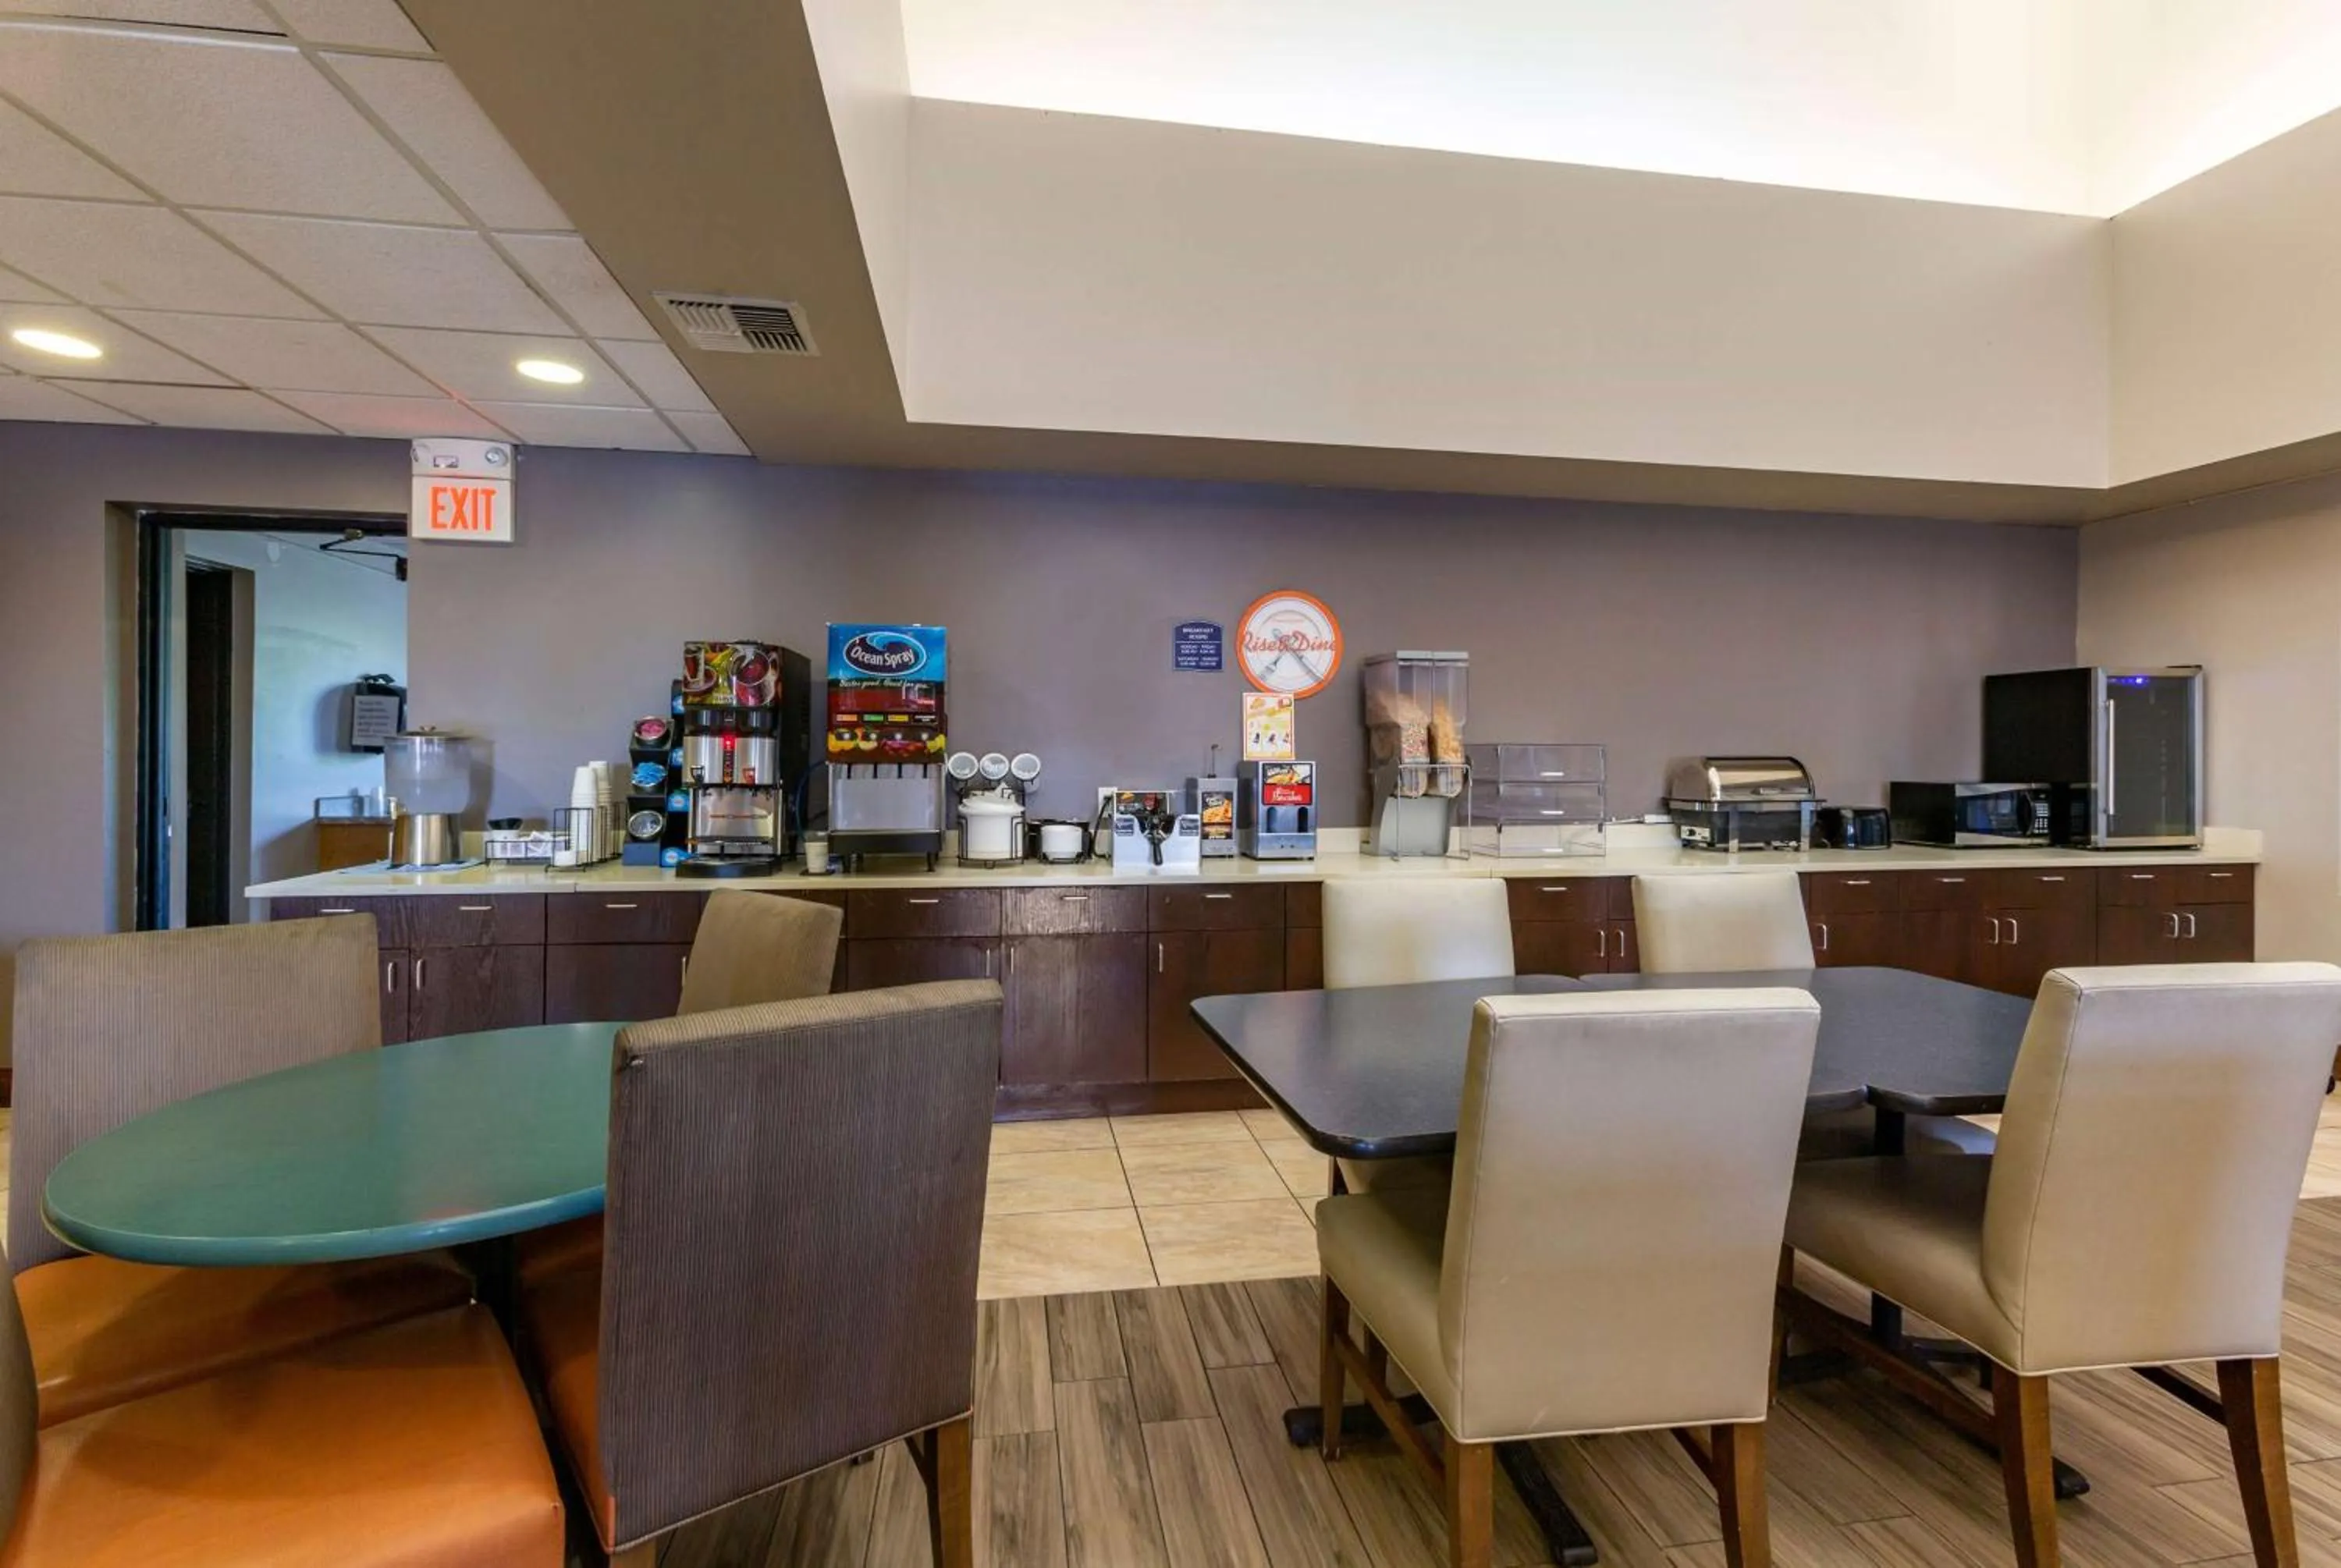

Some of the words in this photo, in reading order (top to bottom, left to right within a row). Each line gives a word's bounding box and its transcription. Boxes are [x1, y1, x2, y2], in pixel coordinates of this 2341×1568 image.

[431, 486, 497, 531] EXIT
[1244, 630, 1278, 653] Rise
[1291, 630, 1337, 653] Dine
[851, 646, 884, 665] Ocean
[884, 648, 915, 669] Spray
